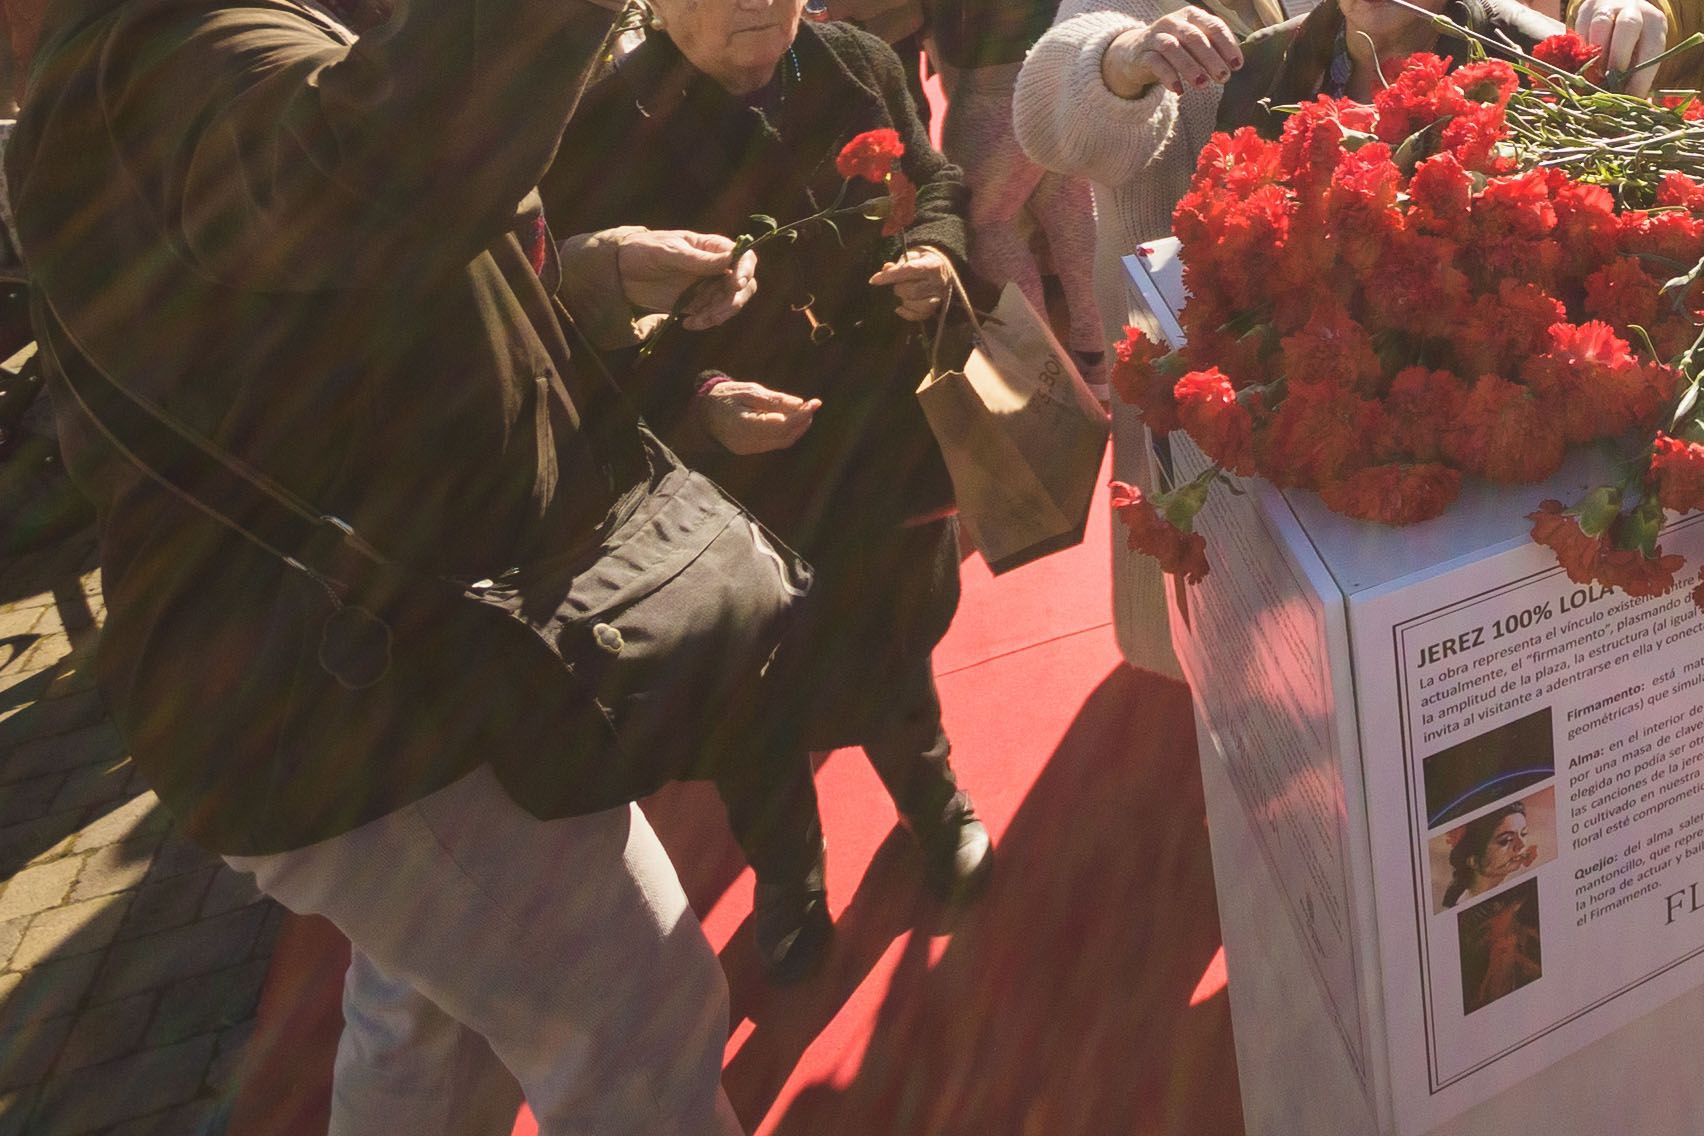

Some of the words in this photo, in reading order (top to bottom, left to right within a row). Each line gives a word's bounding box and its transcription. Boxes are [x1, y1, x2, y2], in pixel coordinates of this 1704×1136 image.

[1417, 626, 1484, 668] JEREZ
[1492, 601, 1552, 639] 100%
[1559, 583, 1615, 611] LOLA
[1418, 676, 1434, 689] La
[1437, 663, 1469, 682] obra
[1472, 635, 1542, 668] representa
[1544, 625, 1557, 640] el
[1420, 668, 1507, 707] actualmente,
[1510, 657, 1522, 672] el
[1616, 598, 1681, 632] plasmando
[1421, 713, 1434, 725] la
[1437, 685, 1496, 719] amplitud
[1499, 680, 1516, 694] de
[1519, 674, 1531, 686] la
[1534, 660, 1570, 682] plaza,
[1573, 652, 1585, 664] la
[1588, 628, 1649, 658] estructura
[1651, 617, 1667, 635] (al
[1669, 605, 1697, 627] igual
[1423, 721, 1460, 743] invita
[1462, 712, 1474, 727] al
[1477, 692, 1532, 720] visitante
[1534, 687, 1543, 698] a
[1545, 660, 1611, 693] adentrarse
[1613, 652, 1629, 665] en
[1631, 642, 1653, 658] ella
[1655, 638, 1663, 651] y
[1566, 683, 1644, 721] Firmamento:
[1646, 689, 1669, 705] que
[1568, 747, 1604, 769] Alma:
[1642, 712, 1684, 737] interior
[1568, 769, 1590, 788] por
[1594, 758, 1617, 774] una
[1621, 743, 1652, 762] masa
[1569, 776, 1613, 802] elegida
[1668, 743, 1686, 758] ser
[1570, 804, 1587, 818] las
[1590, 777, 1647, 809] canciones
[1583, 798, 1636, 828] cultivado
[1658, 769, 1700, 794] nuestra
[1571, 827, 1602, 850] floral
[1622, 839, 1641, 857] del
[1645, 827, 1673, 846] alma
[1574, 857, 1645, 896] mantoncillo,
[1648, 844, 1670, 861] que
[1589, 886, 1616, 905] hora
[1636, 858, 1672, 882] actuar
[1575, 912, 1587, 927] el
[1589, 881, 1661, 920] Firmamento.
